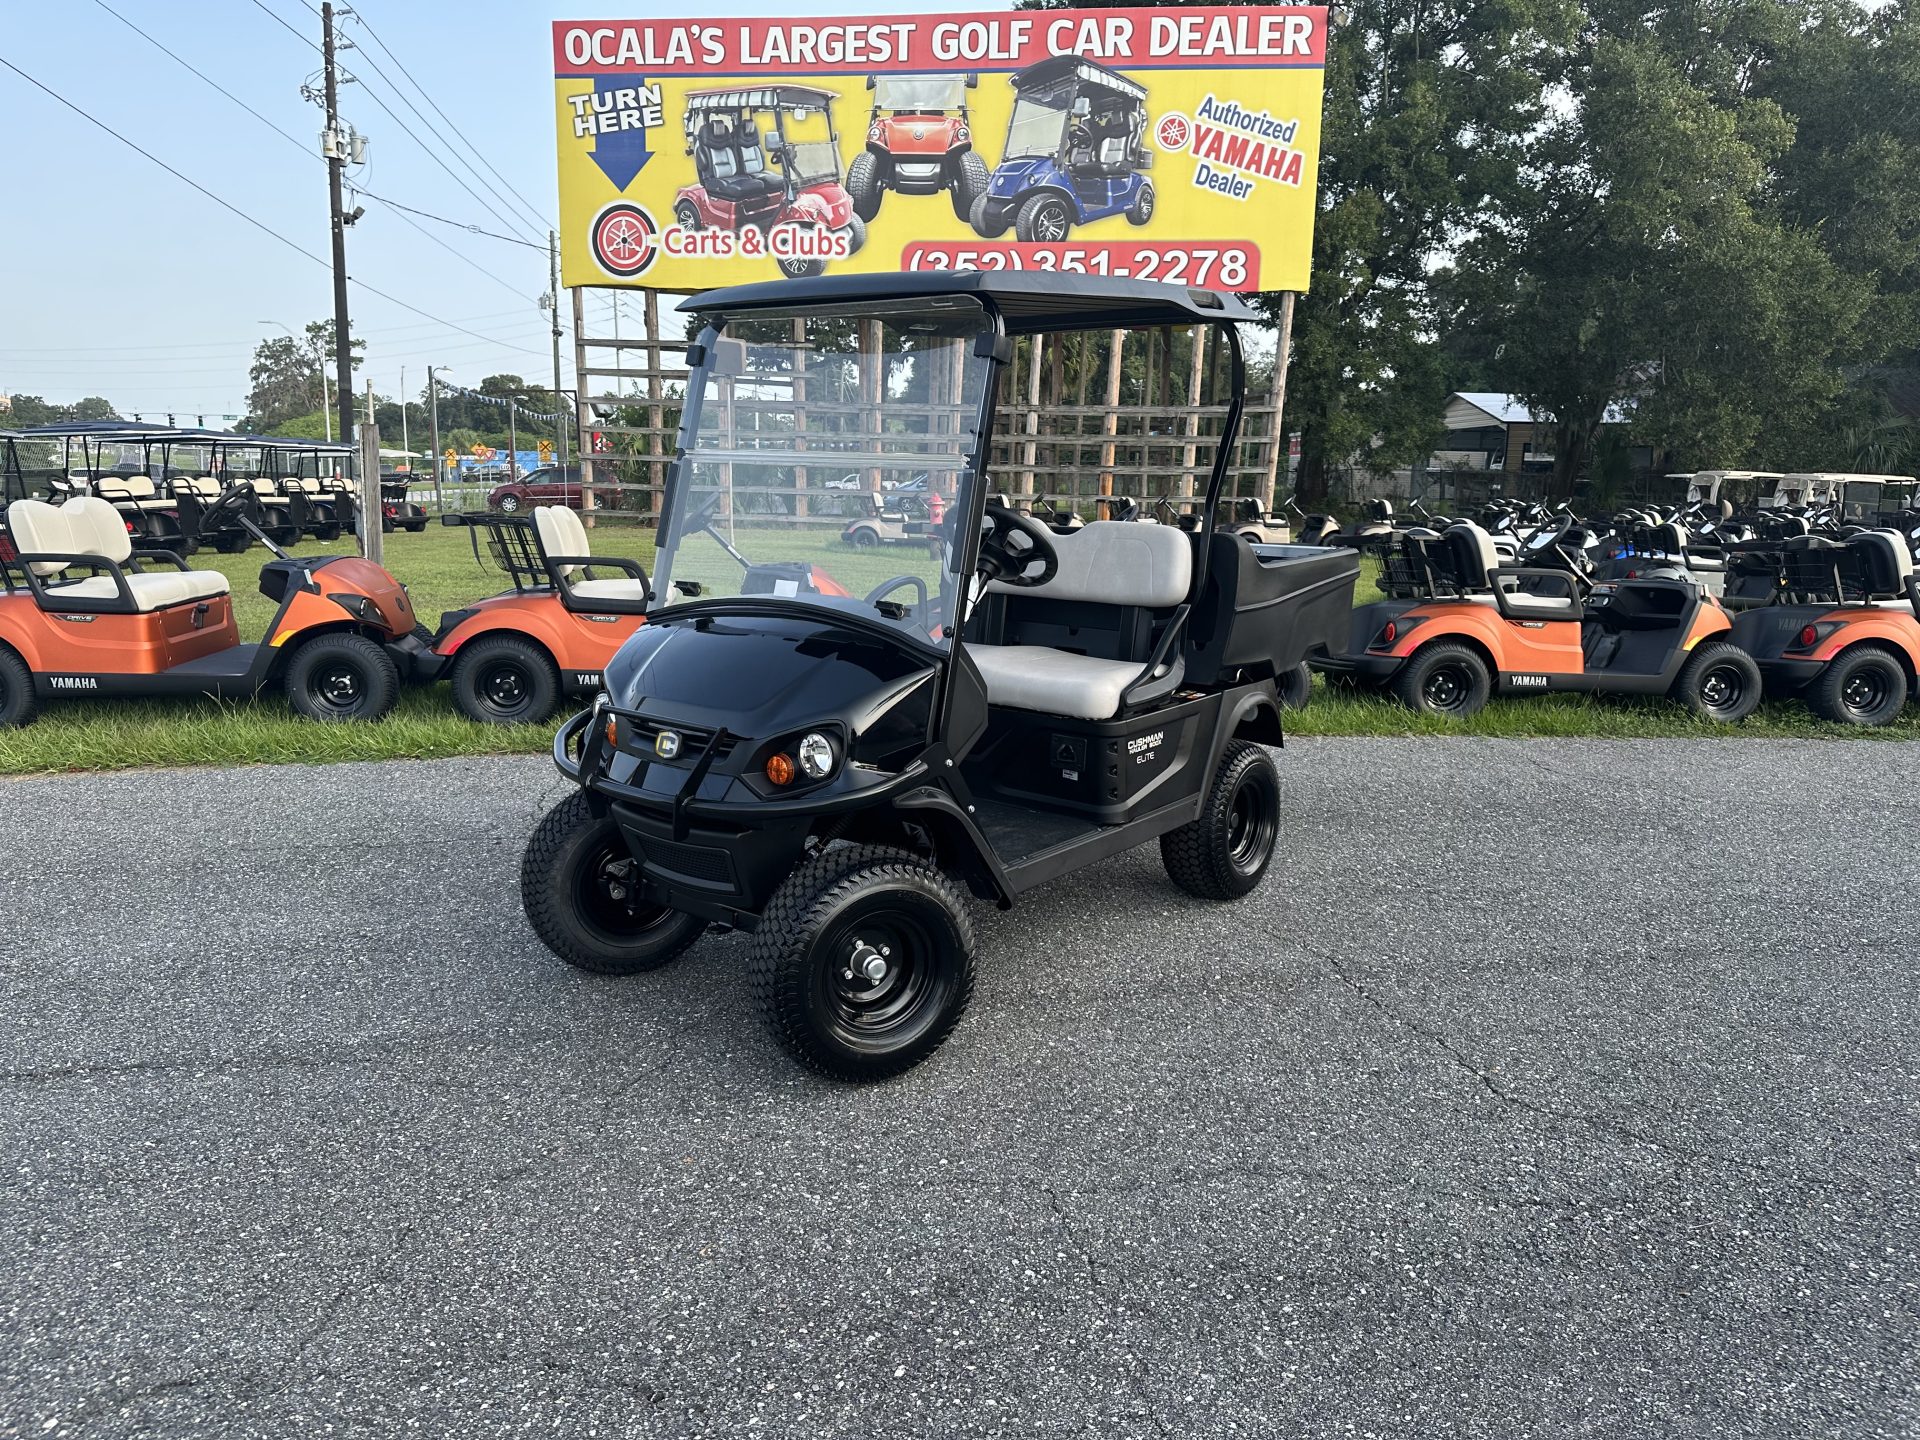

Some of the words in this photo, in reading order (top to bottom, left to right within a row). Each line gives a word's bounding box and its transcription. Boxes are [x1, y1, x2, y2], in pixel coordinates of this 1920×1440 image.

[740, 23, 916, 64] LARGEST
[931, 20, 1033, 60] GOLF
[1046, 17, 1133, 57] CAR
[1149, 15, 1313, 56] DEALER
[568, 84, 661, 115] TURN
[574, 106, 663, 137] HERE
[1198, 96, 1297, 143] Authorized
[1192, 123, 1303, 185] YAMAHA
[1195, 163, 1253, 199] Dealer
[664, 228, 732, 255] Carts
[741, 229, 761, 255] &
[771, 227, 847, 256] Clubs
[1032, 249, 1248, 286] 351-2278
[50, 677, 97, 689] YAMAHA
[577, 674, 599, 685] YAM
[1511, 675, 1547, 686] YAMAHA
[1127, 731, 1164, 750] CUSHMAN
[1136, 751, 1155, 764] ELITE
